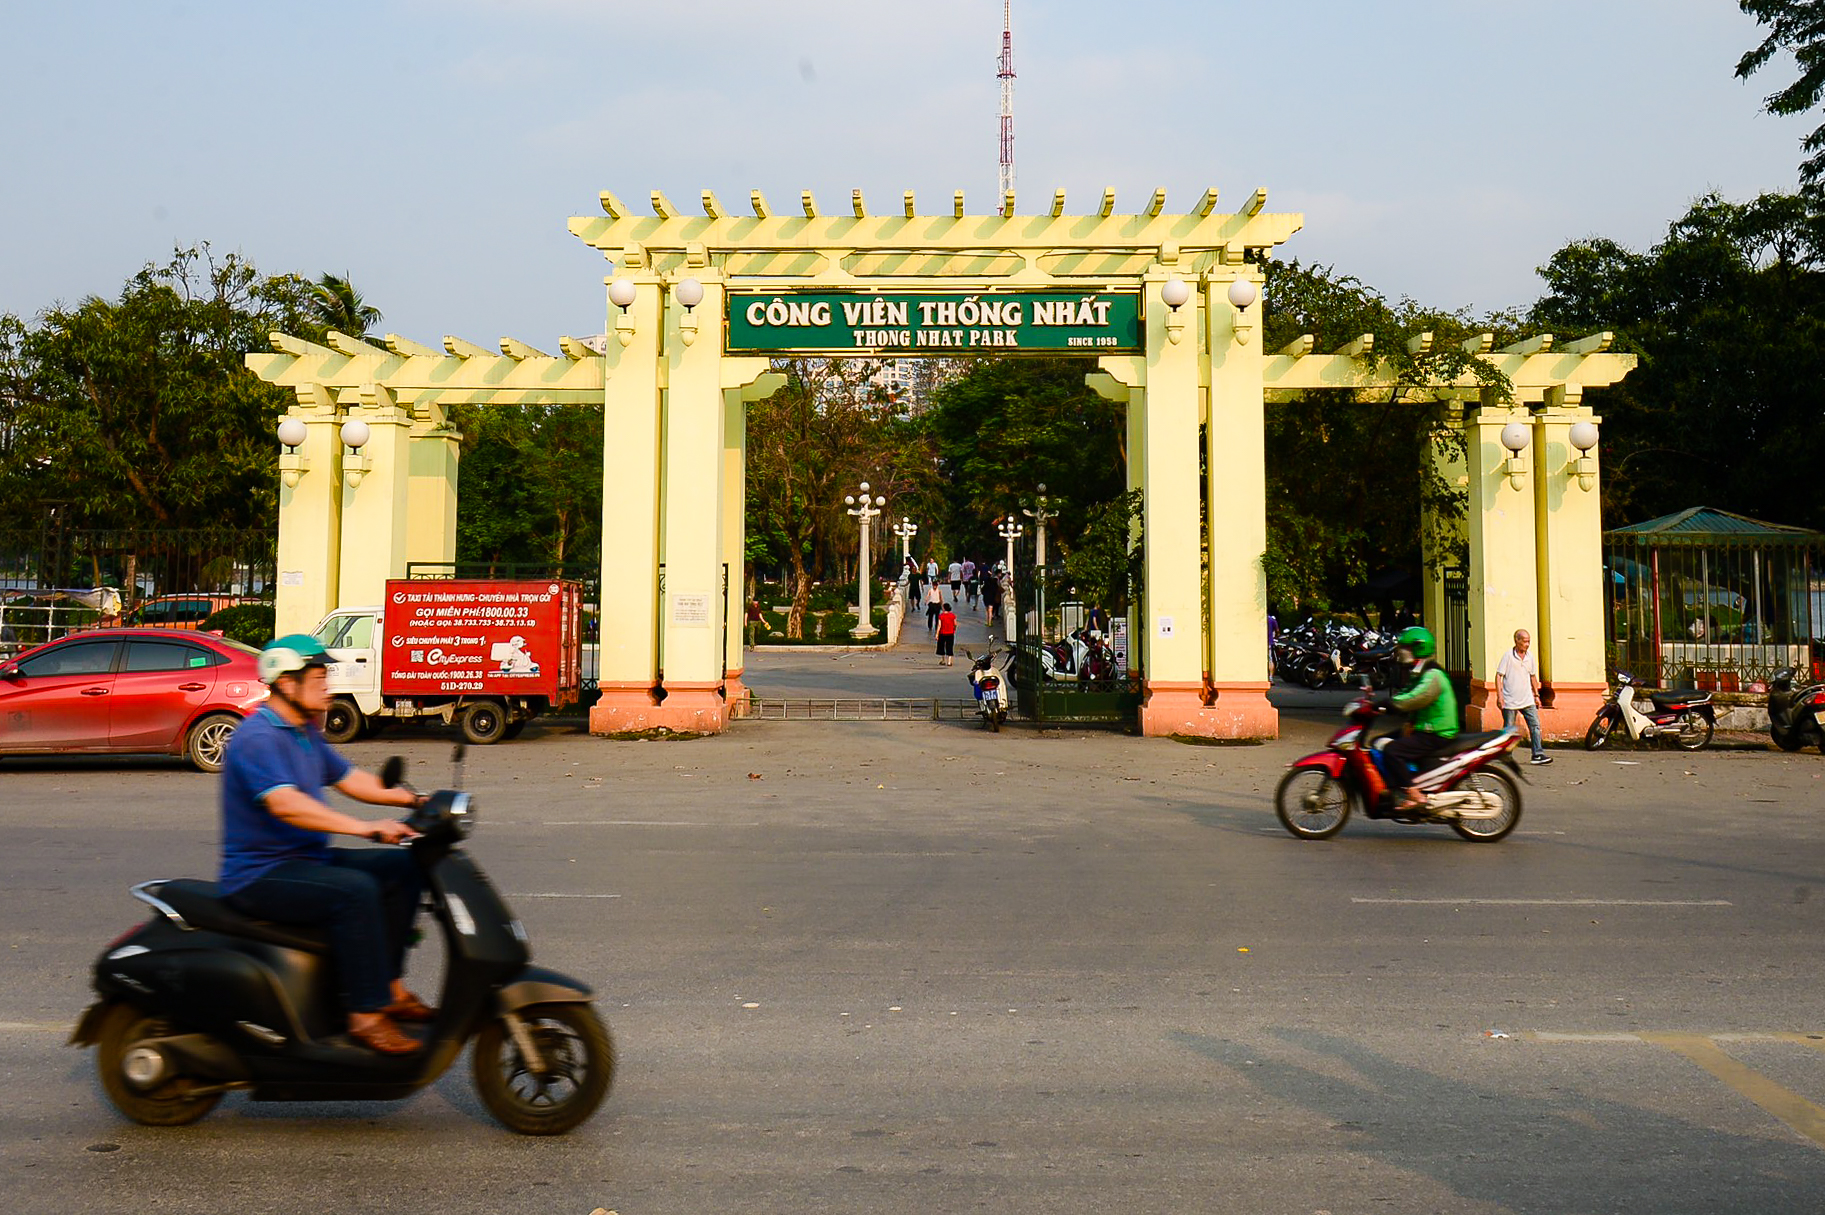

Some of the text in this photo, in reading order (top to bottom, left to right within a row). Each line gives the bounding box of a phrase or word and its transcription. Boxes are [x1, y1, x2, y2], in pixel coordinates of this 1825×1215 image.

[746, 295, 1112, 326] CÔNG VIÊN THỐNG NHẤT
[853, 330, 1018, 347] THONG NHAT PARK
[1067, 336, 1118, 346] SINCE 1958
[407, 593, 421, 602] TAXI
[434, 592, 455, 602] THÀNH
[505, 592, 520, 602] NHÀ
[415, 608, 435, 618] GỌI
[453, 635, 461, 646] 3
